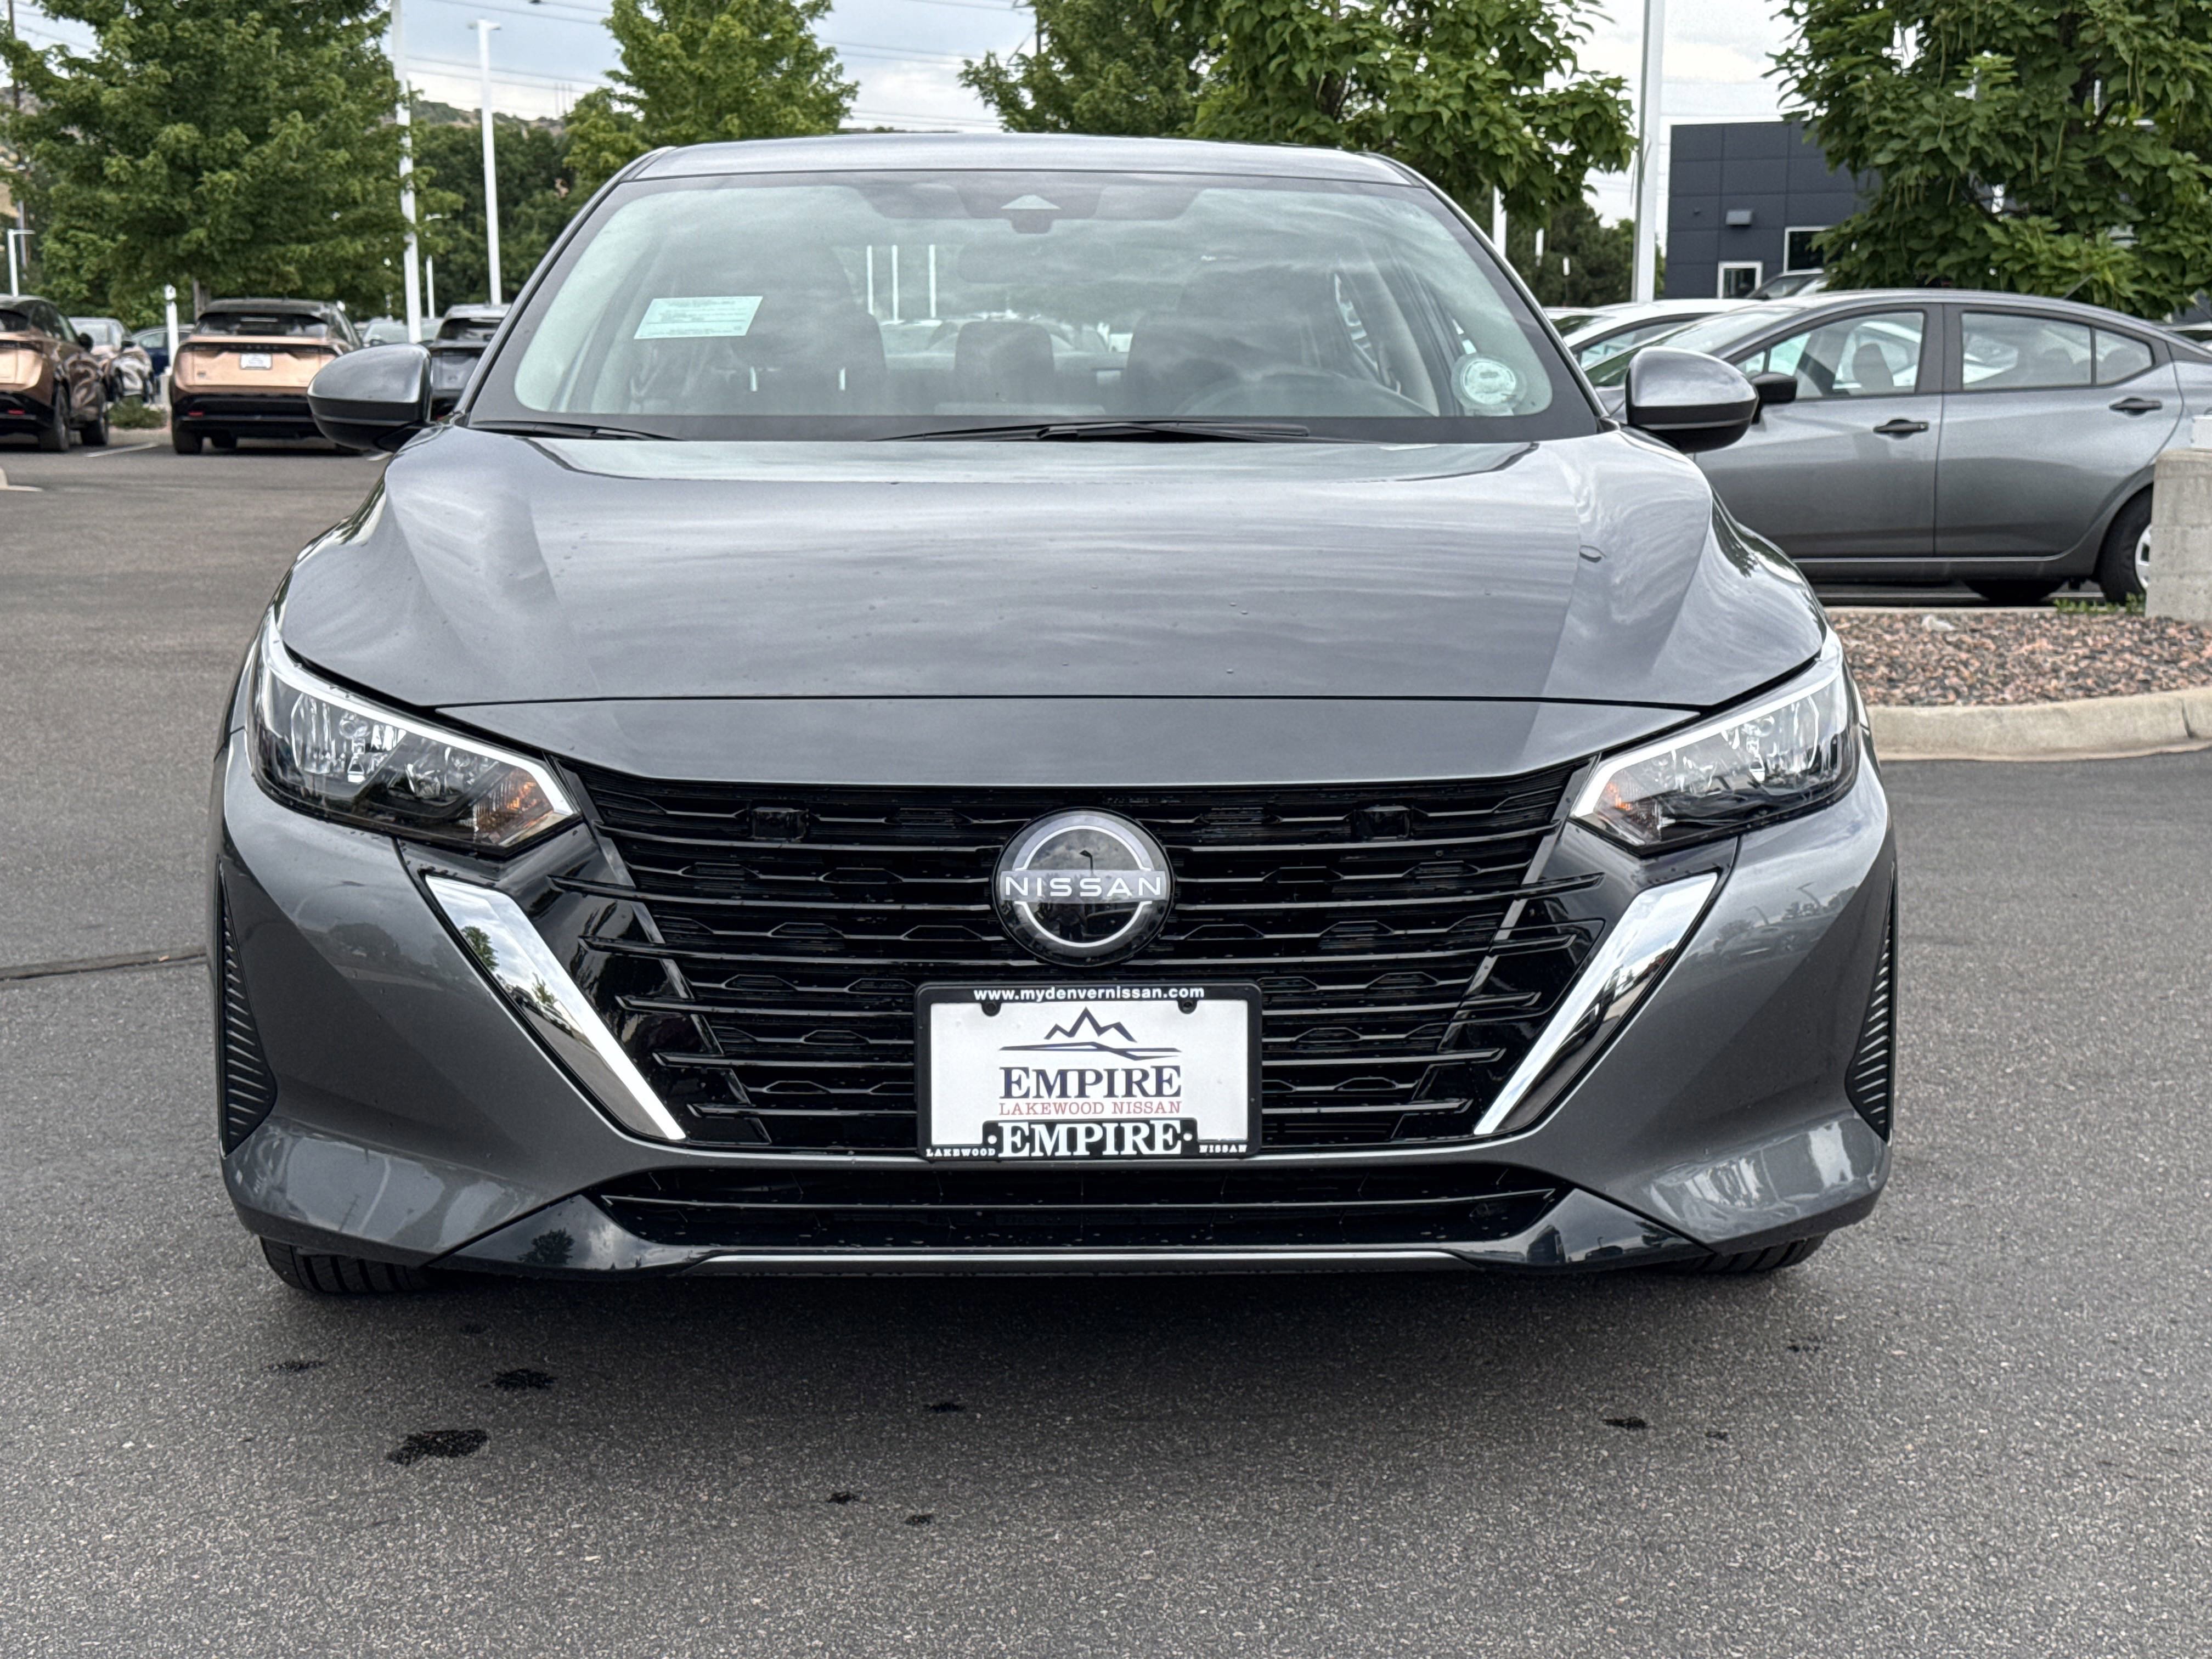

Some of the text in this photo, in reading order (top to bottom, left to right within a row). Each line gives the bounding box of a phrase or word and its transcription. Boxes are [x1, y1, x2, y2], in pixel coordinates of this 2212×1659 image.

[1006, 876, 1161, 897] NISSAN
[973, 986, 1205, 1002] www.mydenvernissan.com
[998, 1065, 1182, 1099] EMPIRE
[999, 1101, 1182, 1116] LAKEWOOD NISSAN
[926, 1120, 1248, 1158] LAKEWOOD EMPIRE NISSAN
